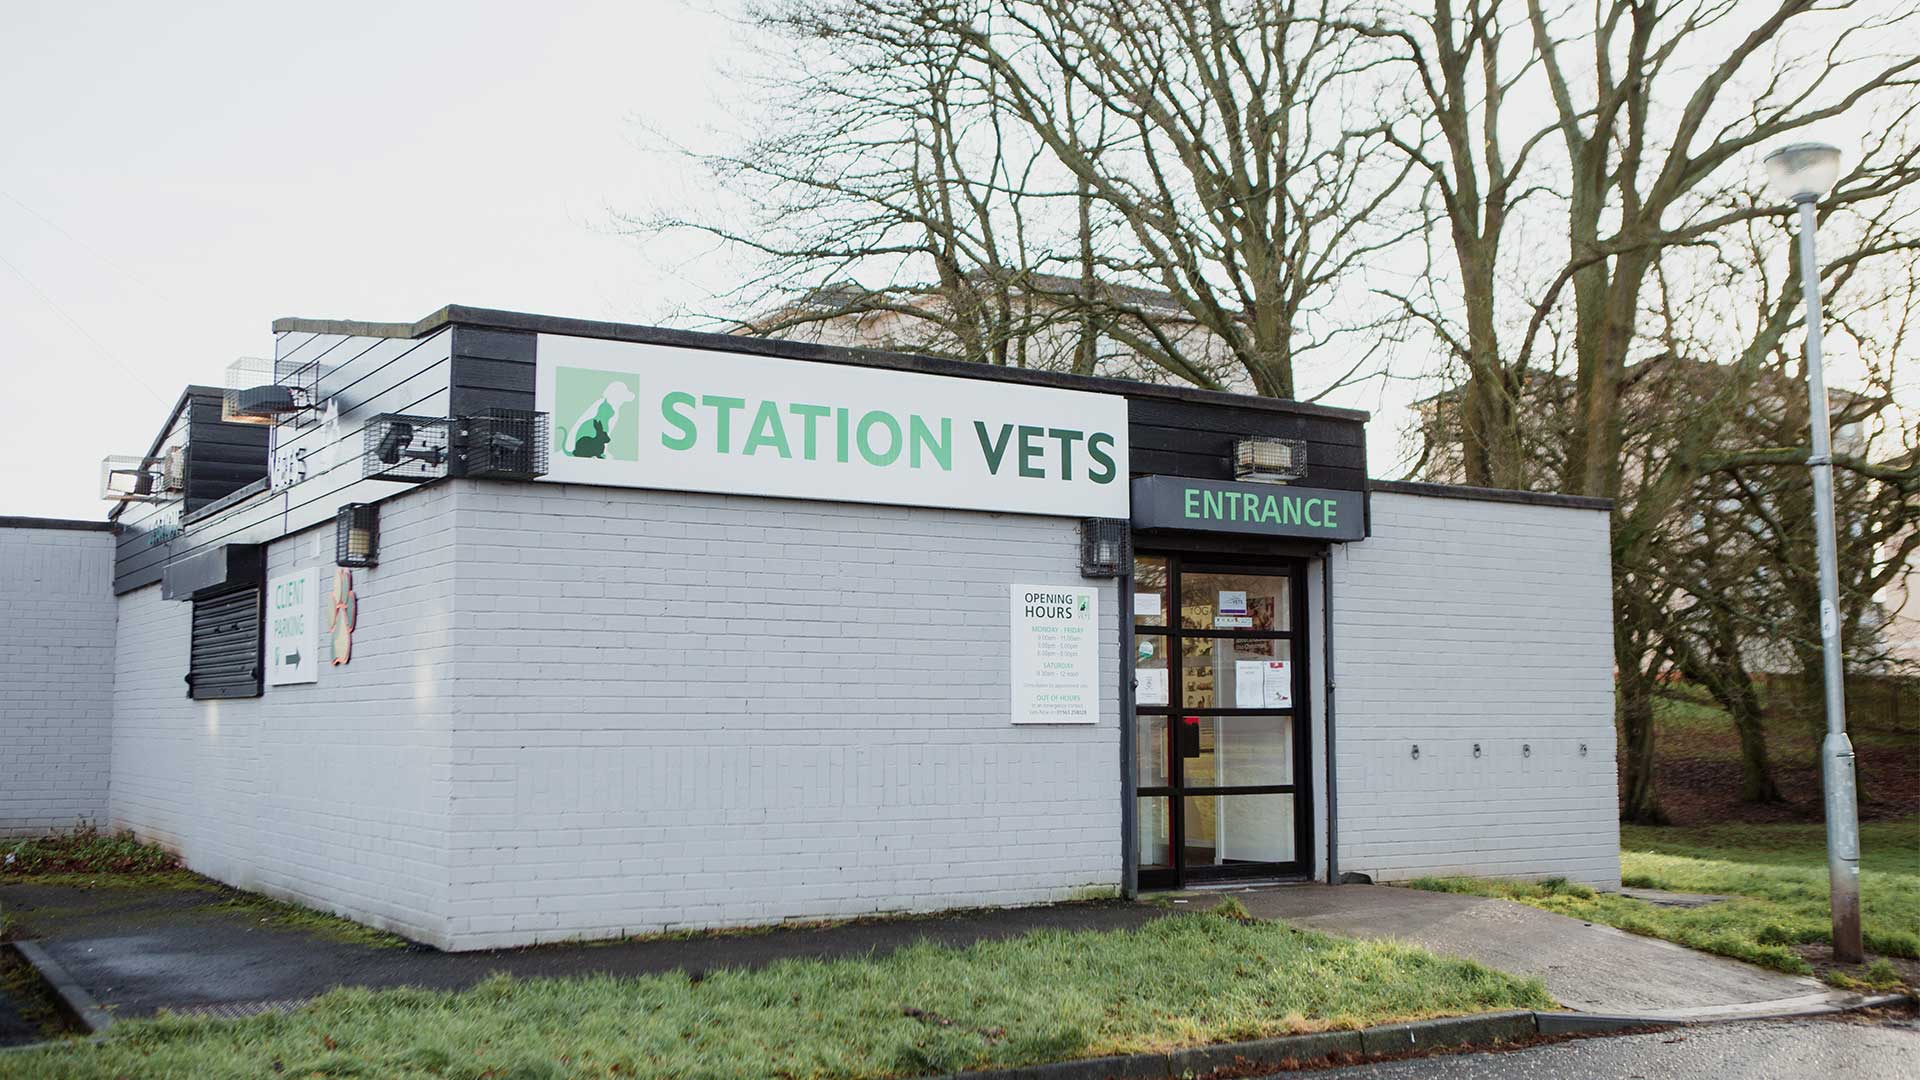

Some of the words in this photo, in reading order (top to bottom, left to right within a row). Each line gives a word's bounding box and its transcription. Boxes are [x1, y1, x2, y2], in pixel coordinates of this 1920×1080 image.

[662, 391, 952, 471] STATION
[974, 420, 1117, 485] VETS
[1184, 488, 1338, 529] ENTRANCE
[1024, 592, 1073, 605] OPENING
[1025, 606, 1073, 619] HOURS
